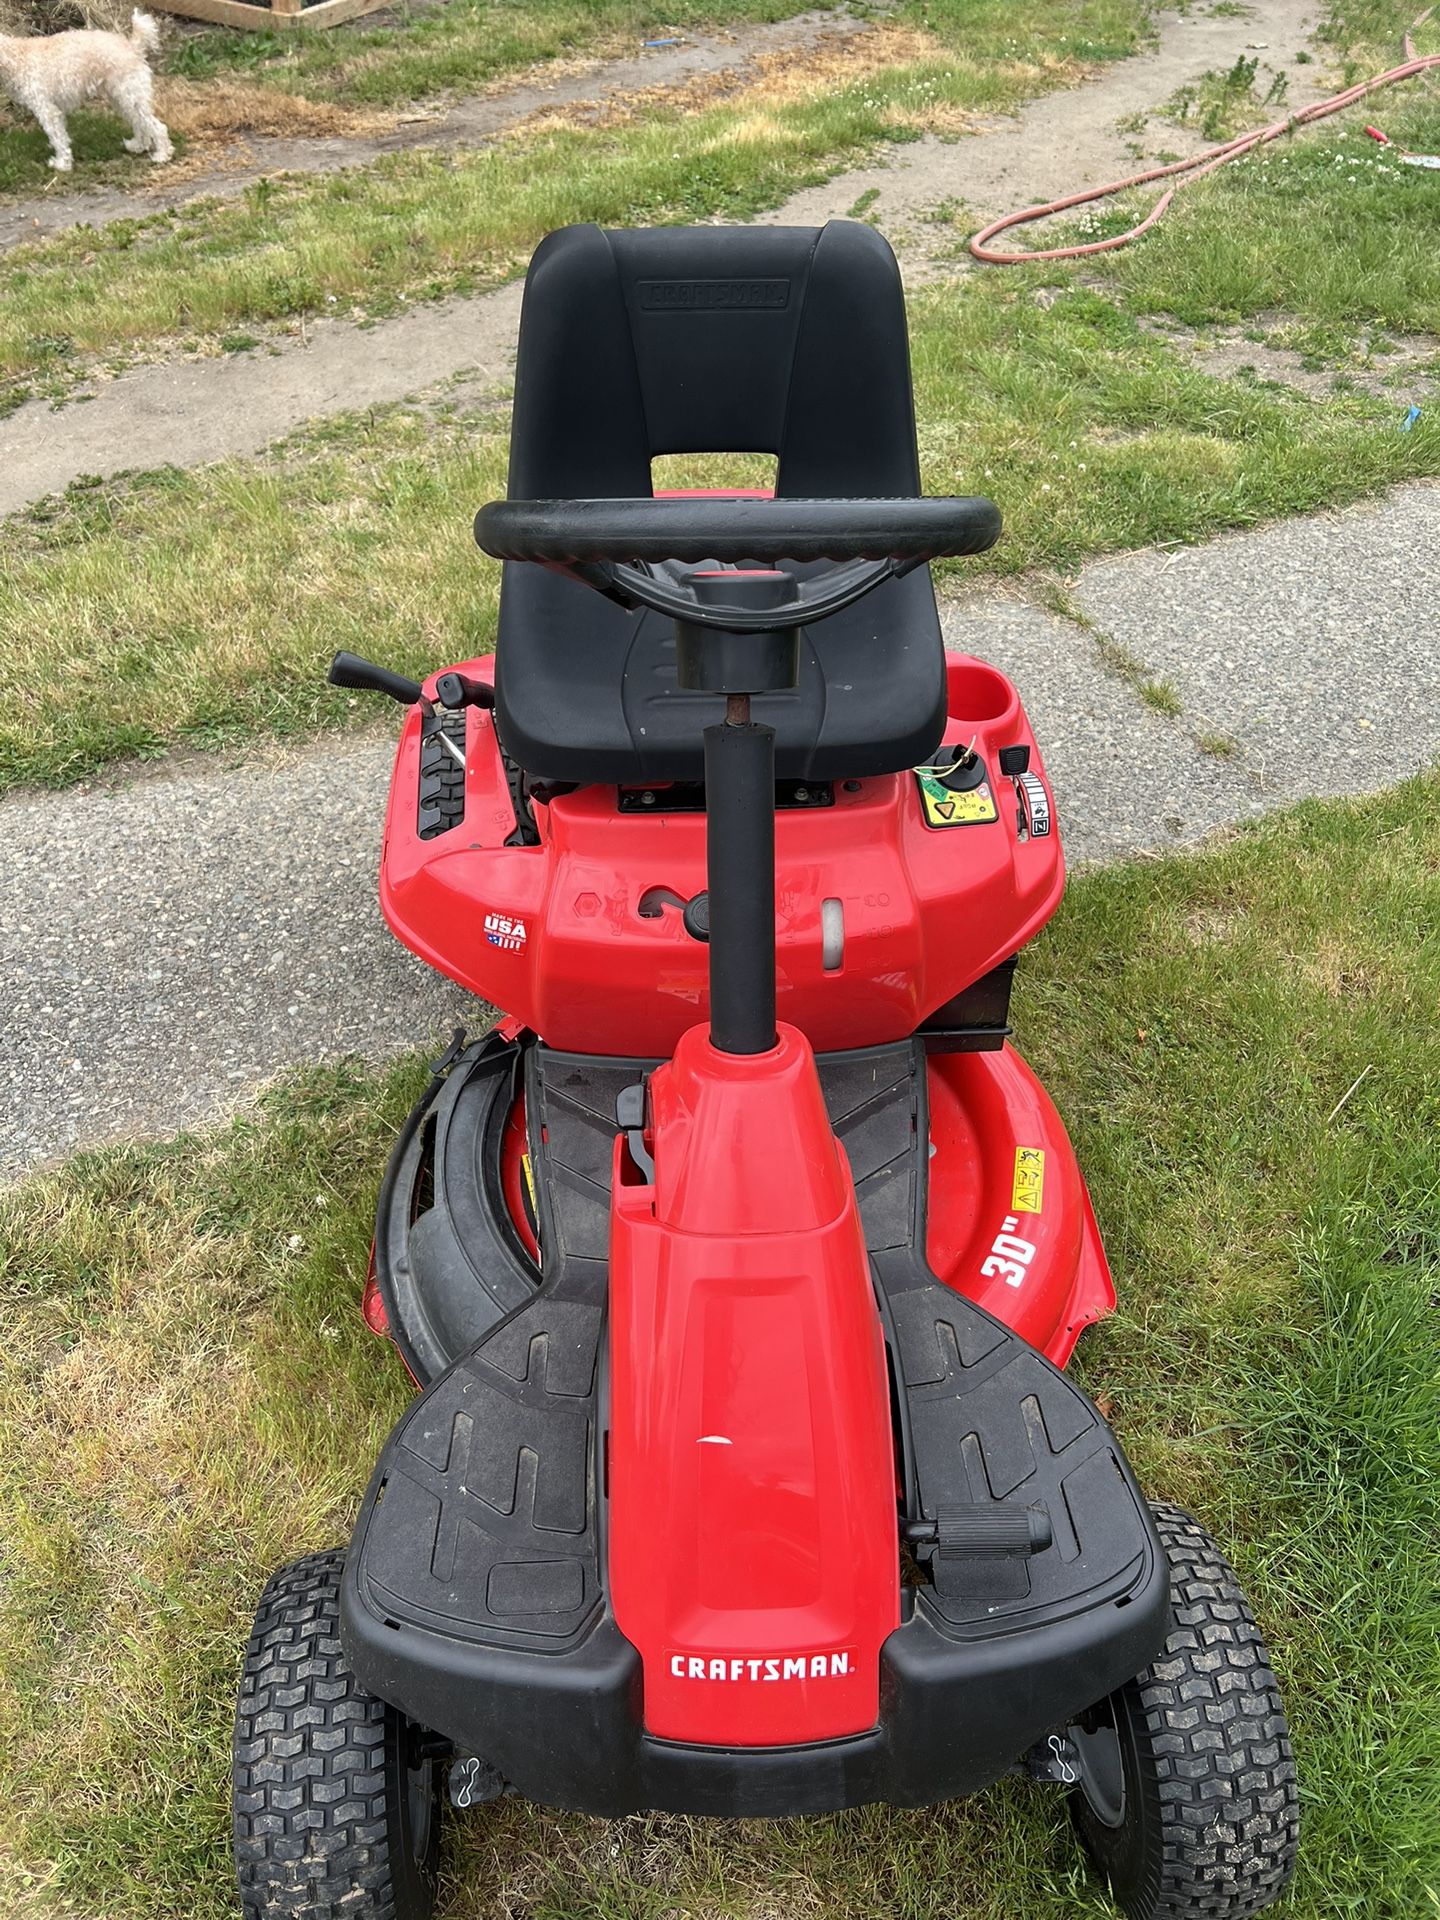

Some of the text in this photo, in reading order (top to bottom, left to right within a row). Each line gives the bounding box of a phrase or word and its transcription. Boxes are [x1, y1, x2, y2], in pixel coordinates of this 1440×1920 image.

[484, 915, 527, 939] USA
[980, 1215, 1036, 1288] 30"
[671, 1652, 849, 1681] CRAFTSMAN
